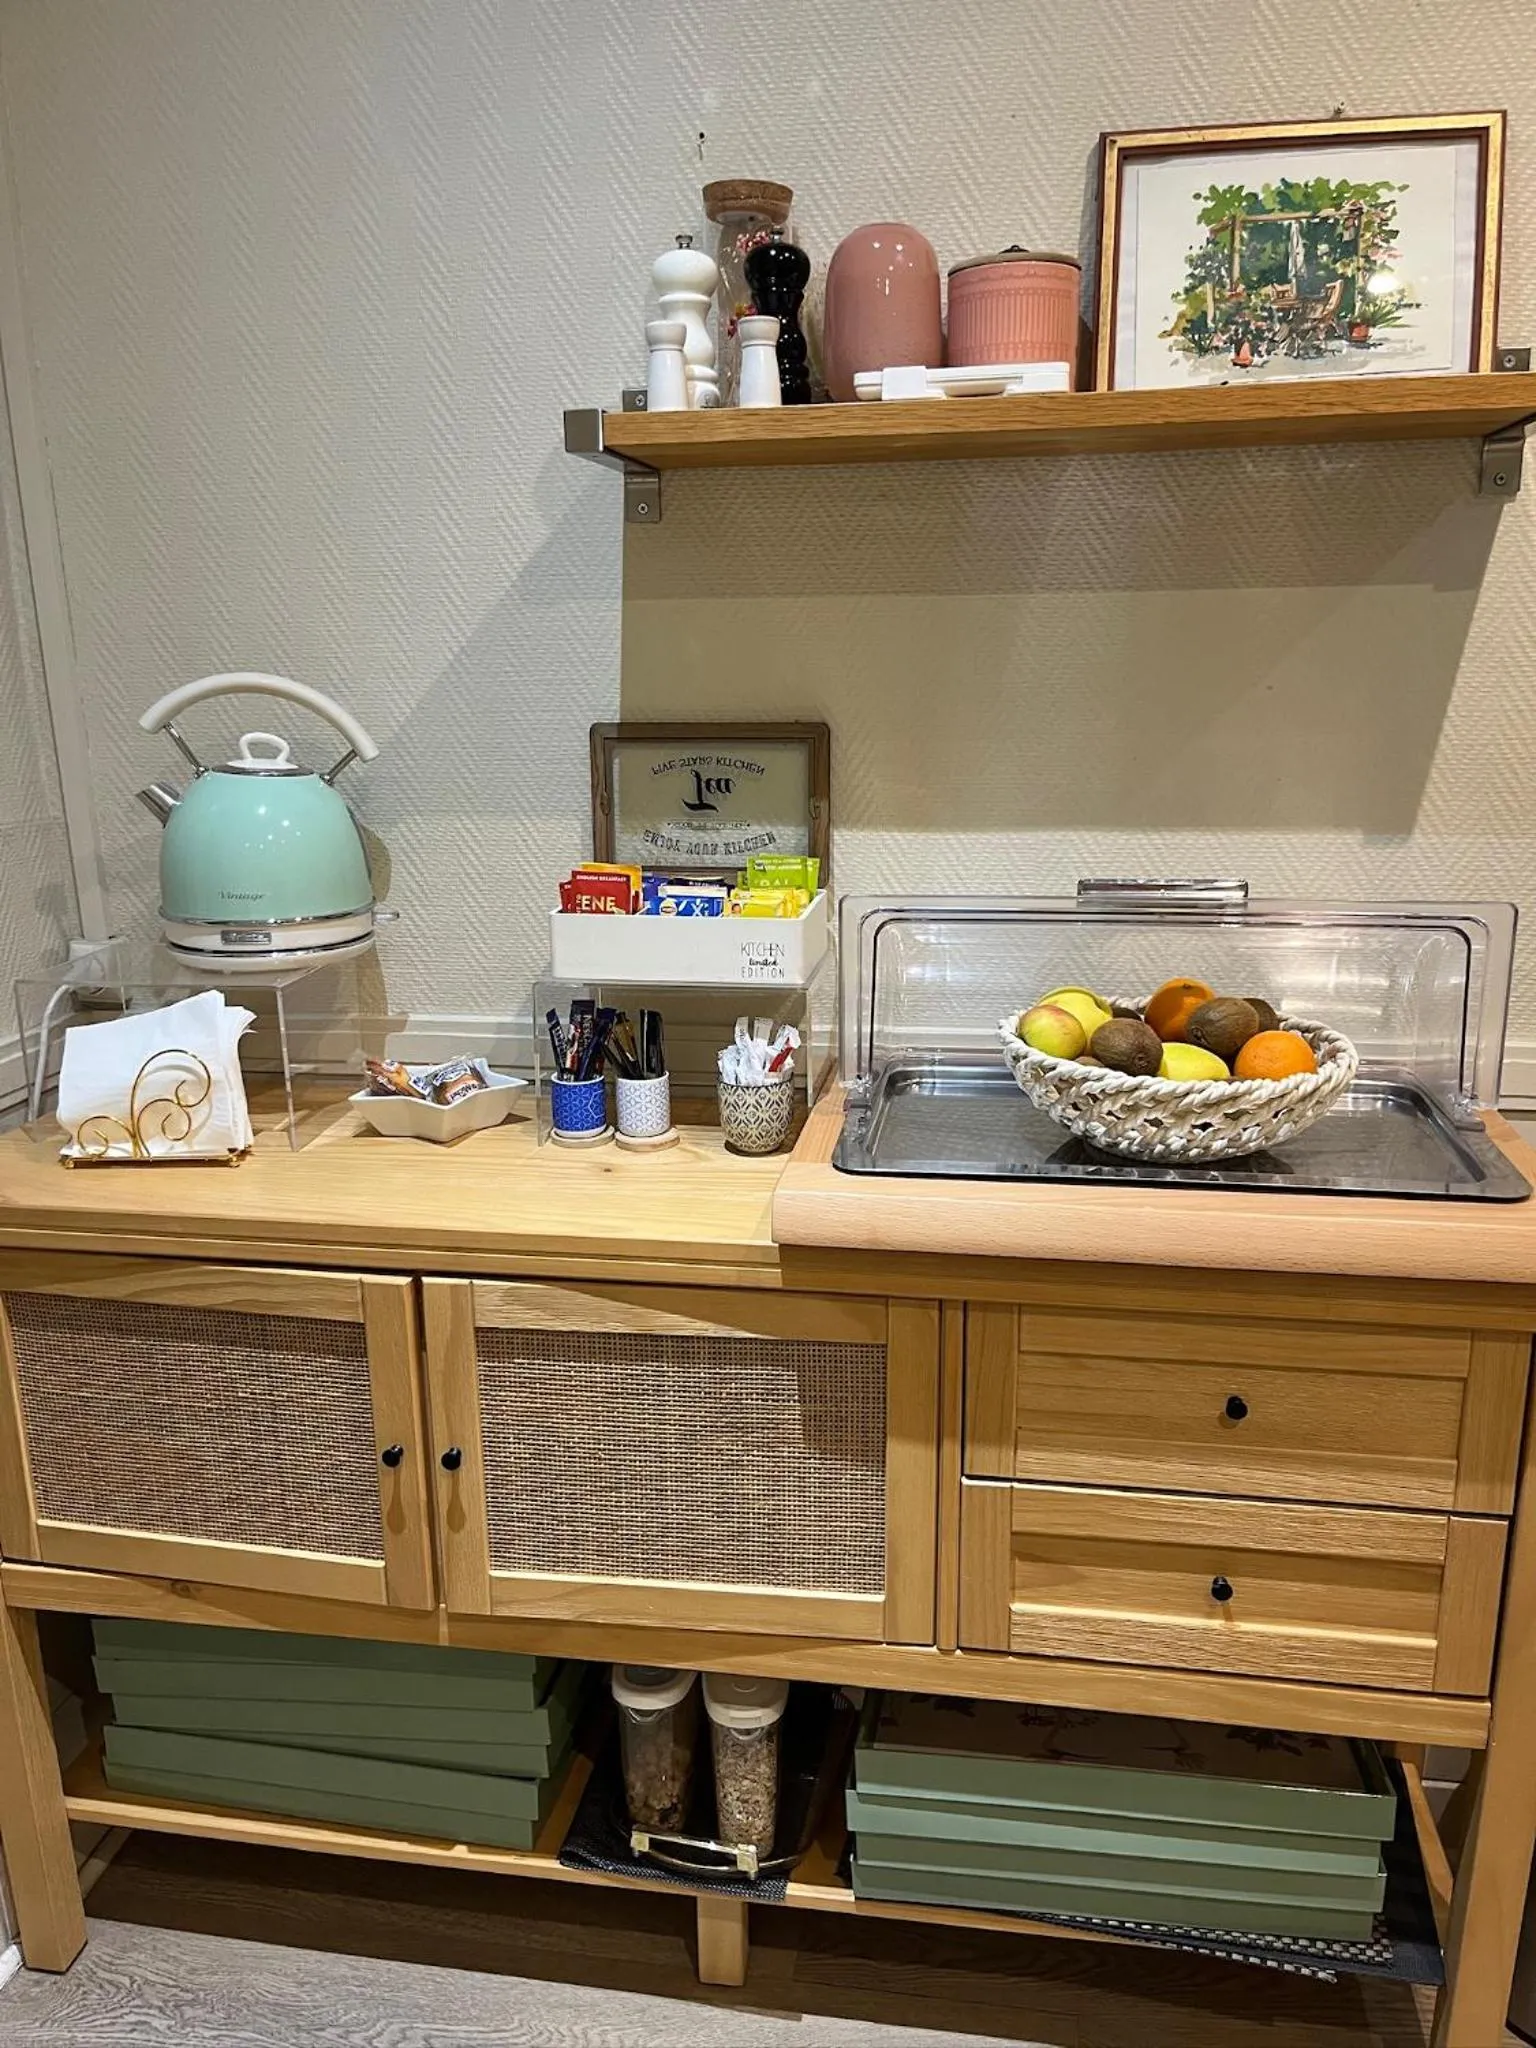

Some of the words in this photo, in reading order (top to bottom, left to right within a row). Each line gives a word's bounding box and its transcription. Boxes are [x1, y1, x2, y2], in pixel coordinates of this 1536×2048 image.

[741, 942, 785, 957] KITCHEN
[749, 957, 779, 967] limited
[741, 966, 785, 979] EDITION
